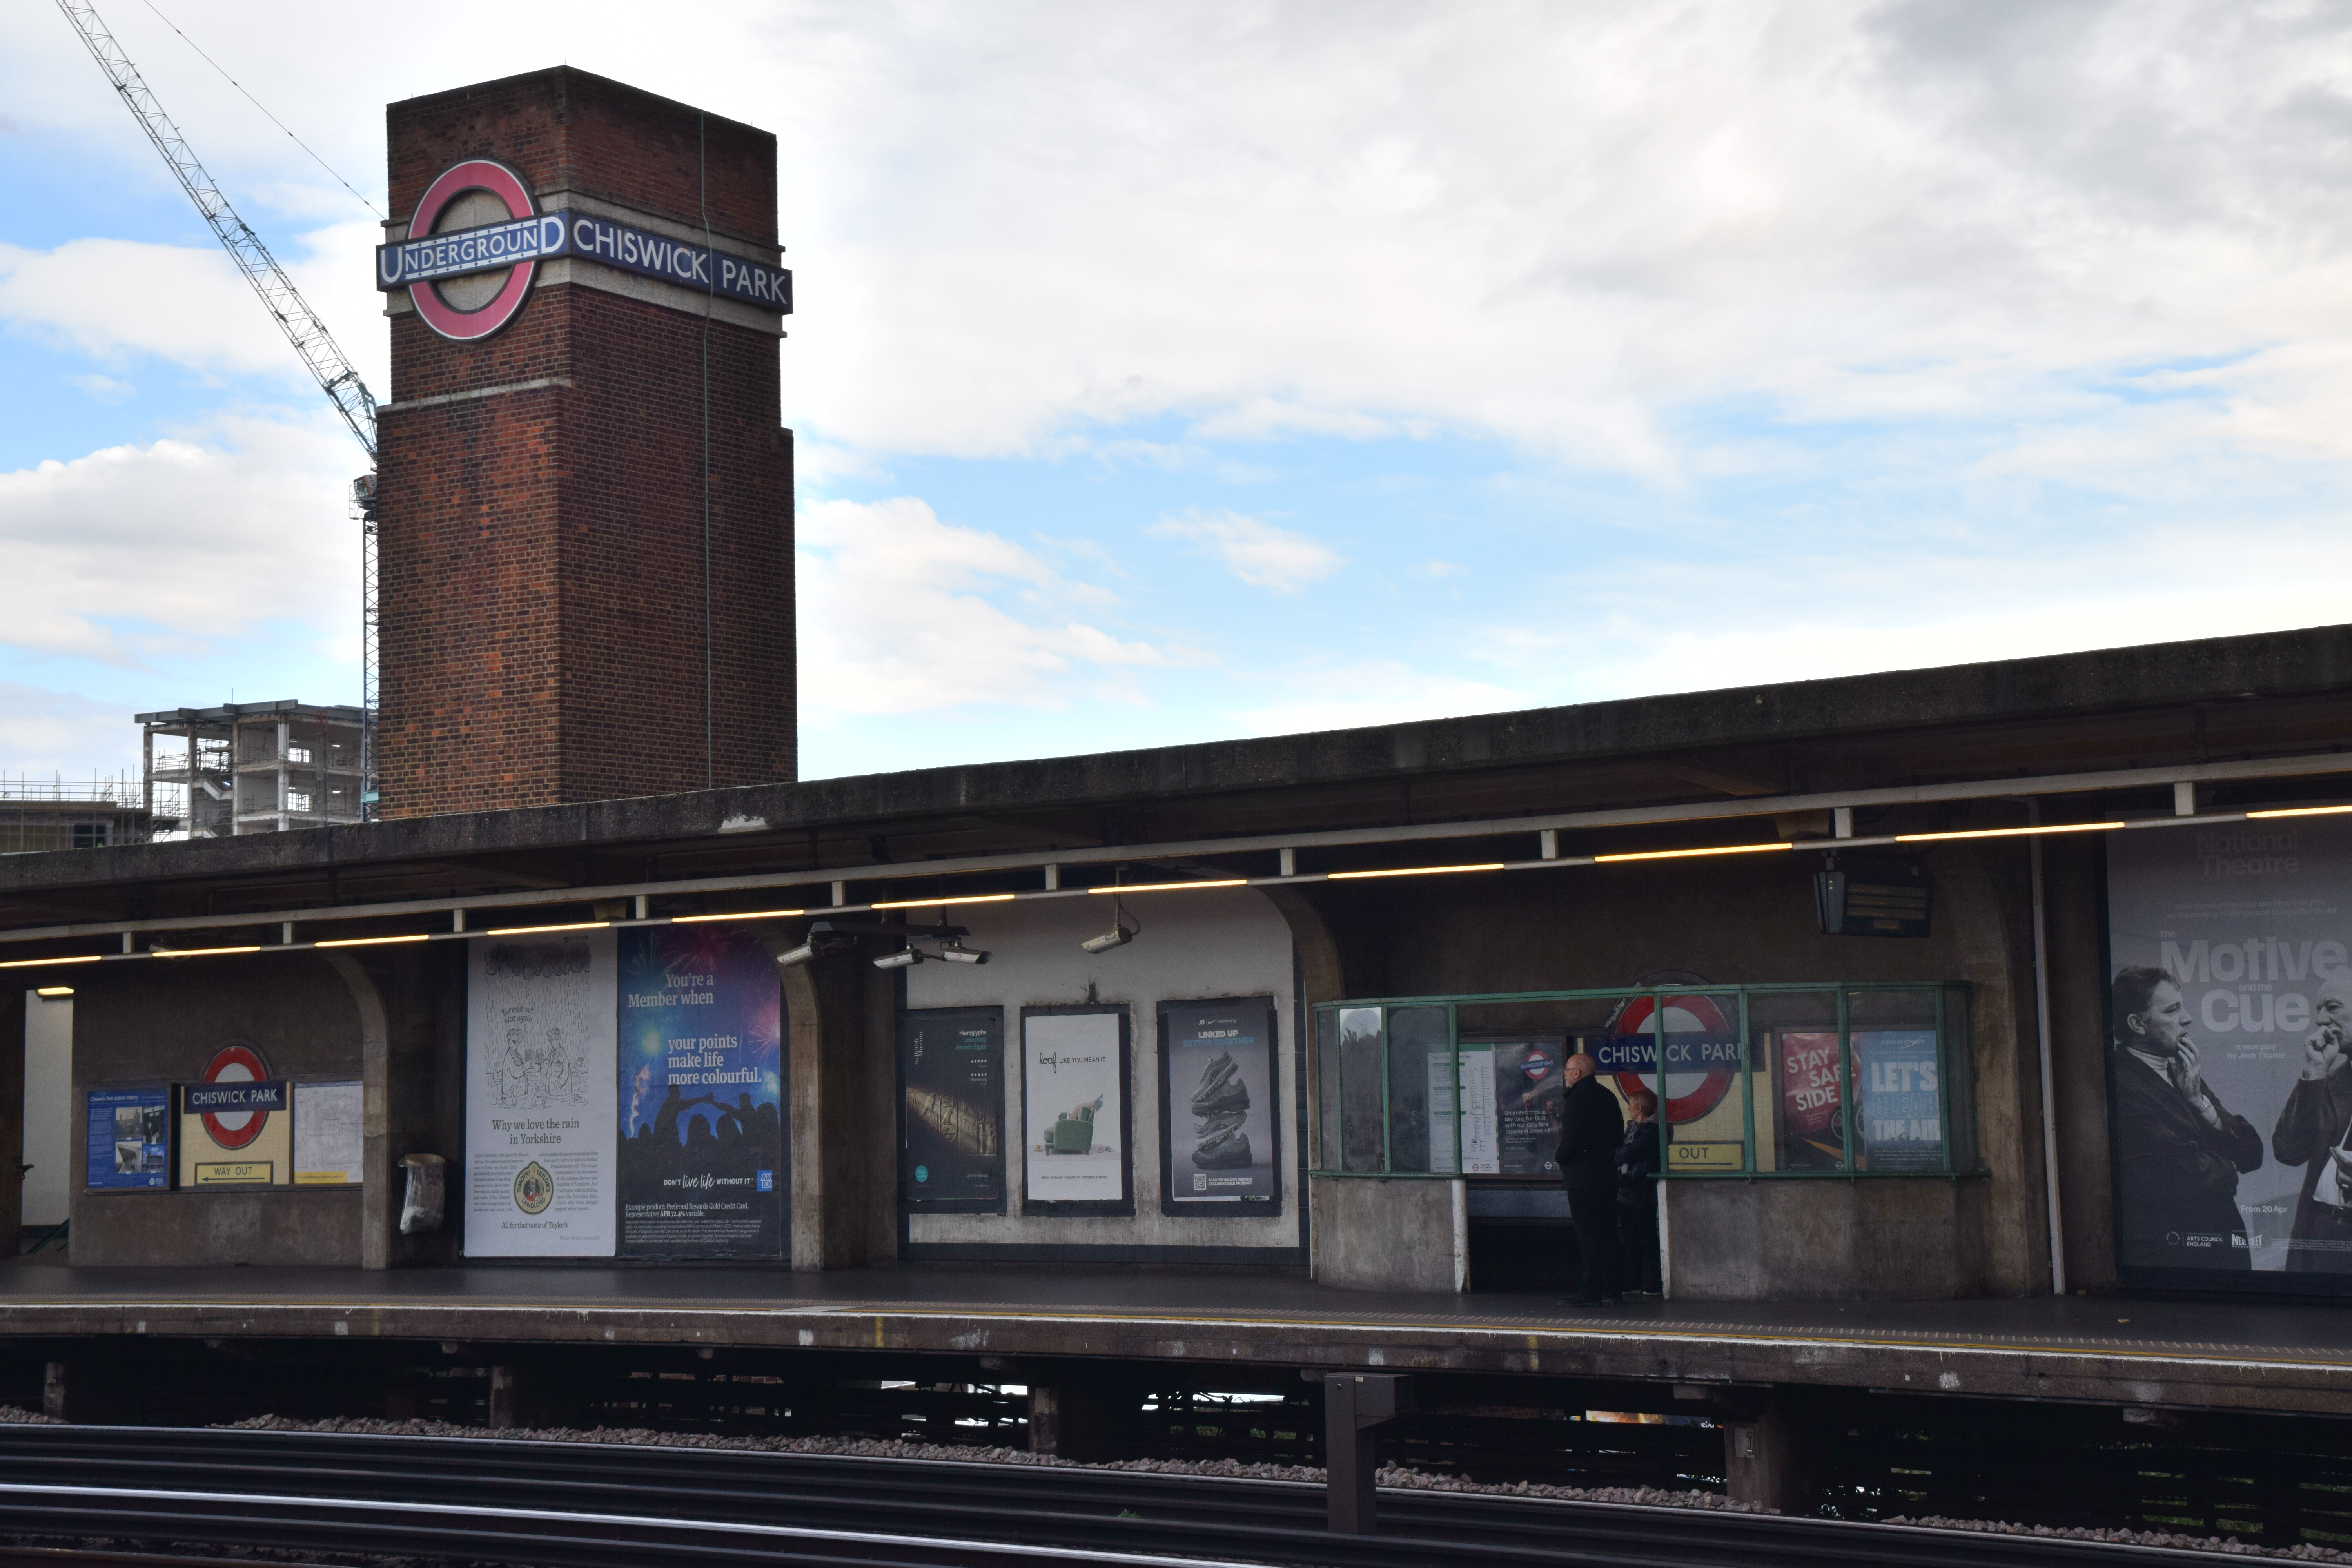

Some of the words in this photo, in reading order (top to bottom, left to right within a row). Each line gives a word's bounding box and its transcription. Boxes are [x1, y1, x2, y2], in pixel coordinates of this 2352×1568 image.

[380, 216, 565, 283] UNDERGROUND
[573, 219, 710, 283] CHISWICK
[722, 259, 788, 305] PARK
[2197, 827, 2298, 854] National
[2198, 853, 2299, 877] Theatre
[2160, 936, 2348, 983] Motive
[666, 973, 704, 988] You're
[707, 974, 714, 986] a
[2256, 983, 2273, 991] the
[628, 991, 679, 1008] Member
[680, 989, 714, 1005] when
[501, 1004, 524, 1017] Turned
[2201, 989, 2311, 1033] Cue
[505, 1016, 515, 1024] nice
[517, 1015, 532, 1024] again
[1198, 1030, 1226, 1039] LINKED
[1213, 1036, 1254, 1045] TOGETHER
[668, 1038, 696, 1054] your
[699, 1033, 738, 1053] points
[2260, 1044, 2276, 1053] play
[668, 1052, 701, 1068] make
[704, 1051, 724, 1067] life
[1599, 1045, 1692, 1063] CHISWCK
[1787, 1047, 1830, 1074] STAY
[2227, 1052, 2237, 1060] by
[1039, 1052, 1057, 1074] loaf
[668, 1072, 699, 1085] more
[701, 1067, 762, 1085] colourful.
[1809, 1063, 1856, 1087] SAF
[1871, 1061, 1938, 1092] LET'S
[192, 1090, 246, 1105] CHISWICK
[251, 1088, 278, 1103] PARK
[1795, 1086, 1838, 1111] SIDE
[1872, 1093, 1939, 1122] CLEAR
[492, 1120, 512, 1132] Why
[527, 1119, 544, 1129] love
[546, 1118, 560, 1129] the
[561, 1118, 579, 1128] rain
[1873, 1119, 1906, 1141] THE
[510, 1134, 518, 1144] in
[520, 1133, 561, 1144] Yorkshire
[1679, 1147, 1709, 1159] OUT
[214, 1167, 230, 1176] WAY
[236, 1166, 252, 1175] OUT
[517, 1170, 531, 1193] TIMOTHY
[537, 1169, 551, 1193] TAYLOR'S
[682, 1174, 699, 1189] live
[700, 1173, 715, 1190] life
[521, 1197, 546, 1209] LANDLORD
[625, 1203, 646, 1212] Example
[646, 1203, 666, 1211] product:
[2240, 1205, 2261, 1213] From
[2273, 1205, 2288, 1214] Apr
[625, 1210, 659, 1219] Representative
[548, 1221, 568, 1230] Taylor's
[2231, 1233, 2247, 1246] NEAL
